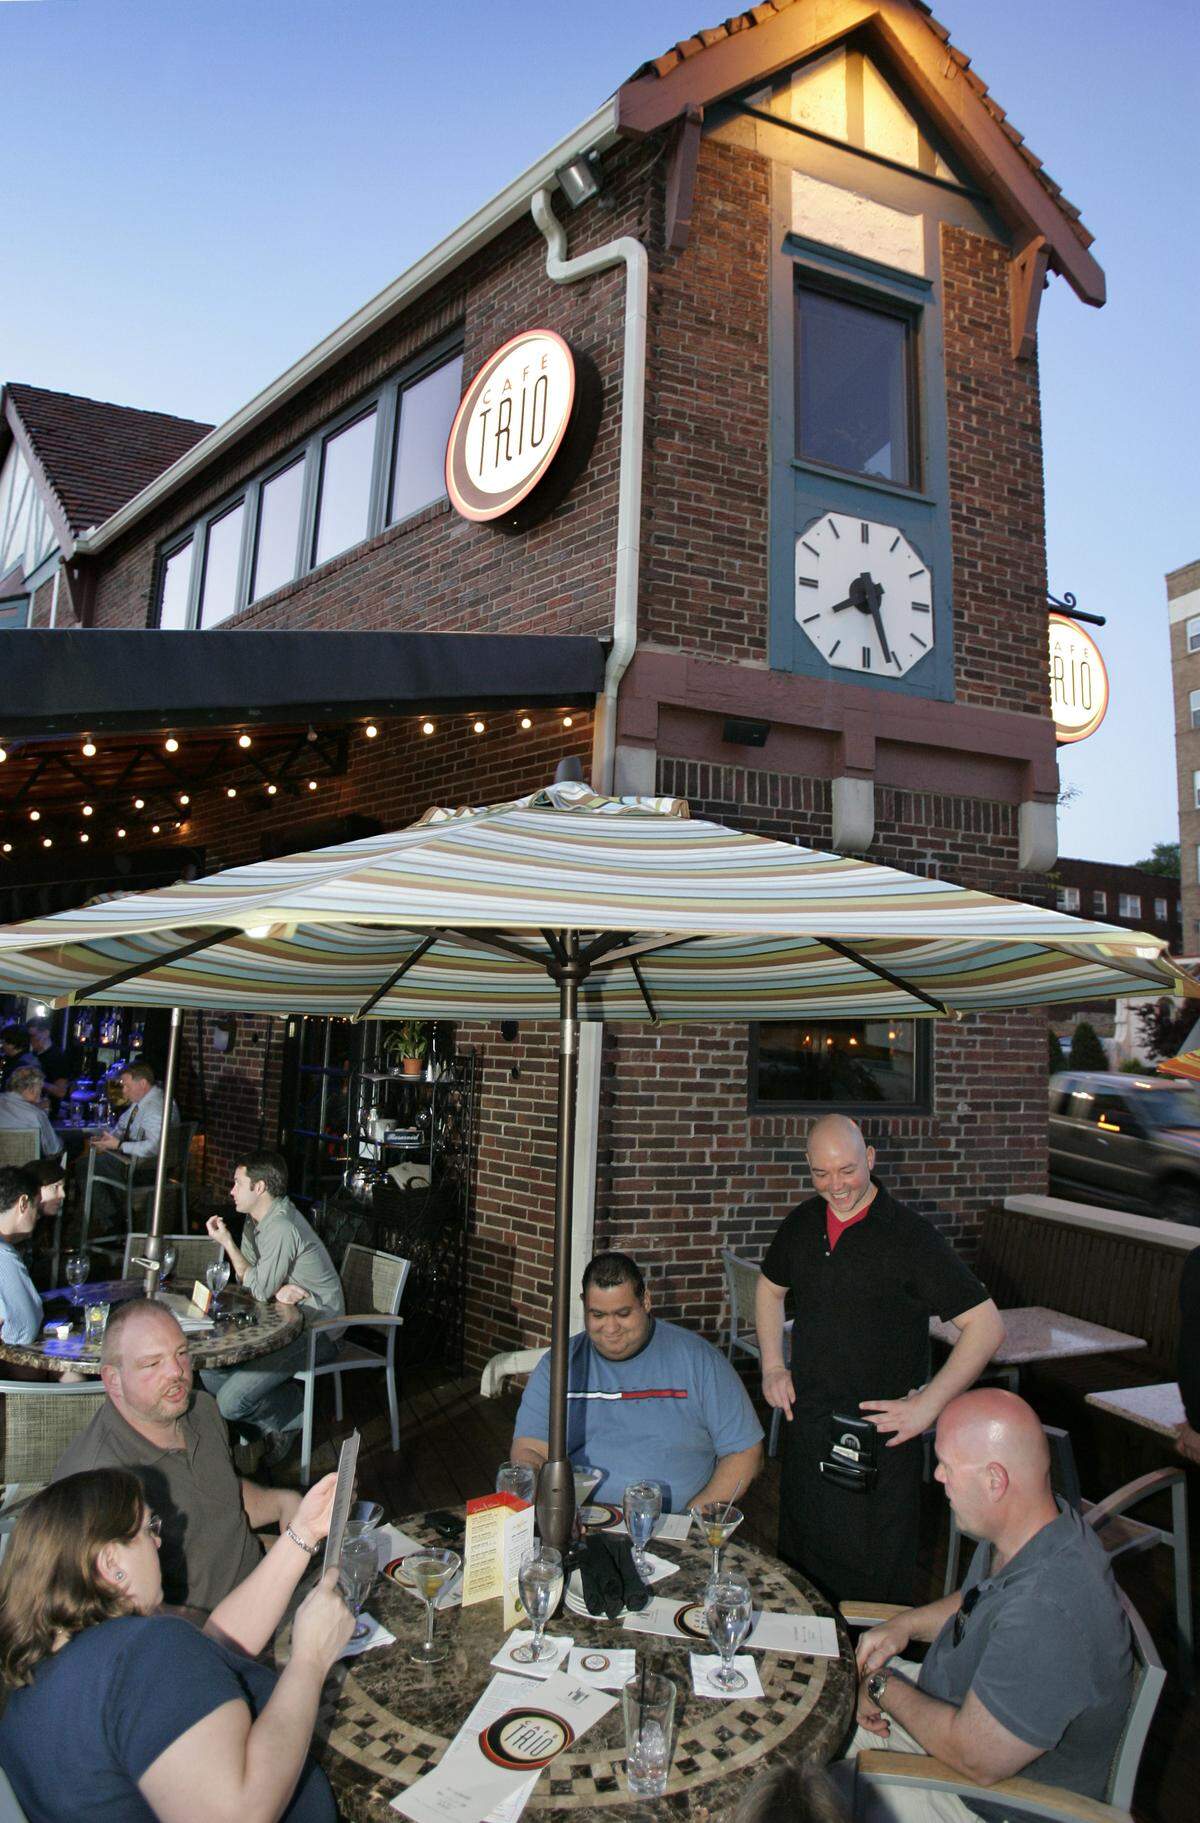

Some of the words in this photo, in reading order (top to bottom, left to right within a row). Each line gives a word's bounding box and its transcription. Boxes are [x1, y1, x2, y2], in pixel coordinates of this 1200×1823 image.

[483, 353, 548, 404] CAFE
[479, 375, 548, 476] TRIO
[1054, 641, 1089, 659] AFE
[1050, 655, 1092, 710] RIO
[503, 1723, 553, 1757] TRIO
